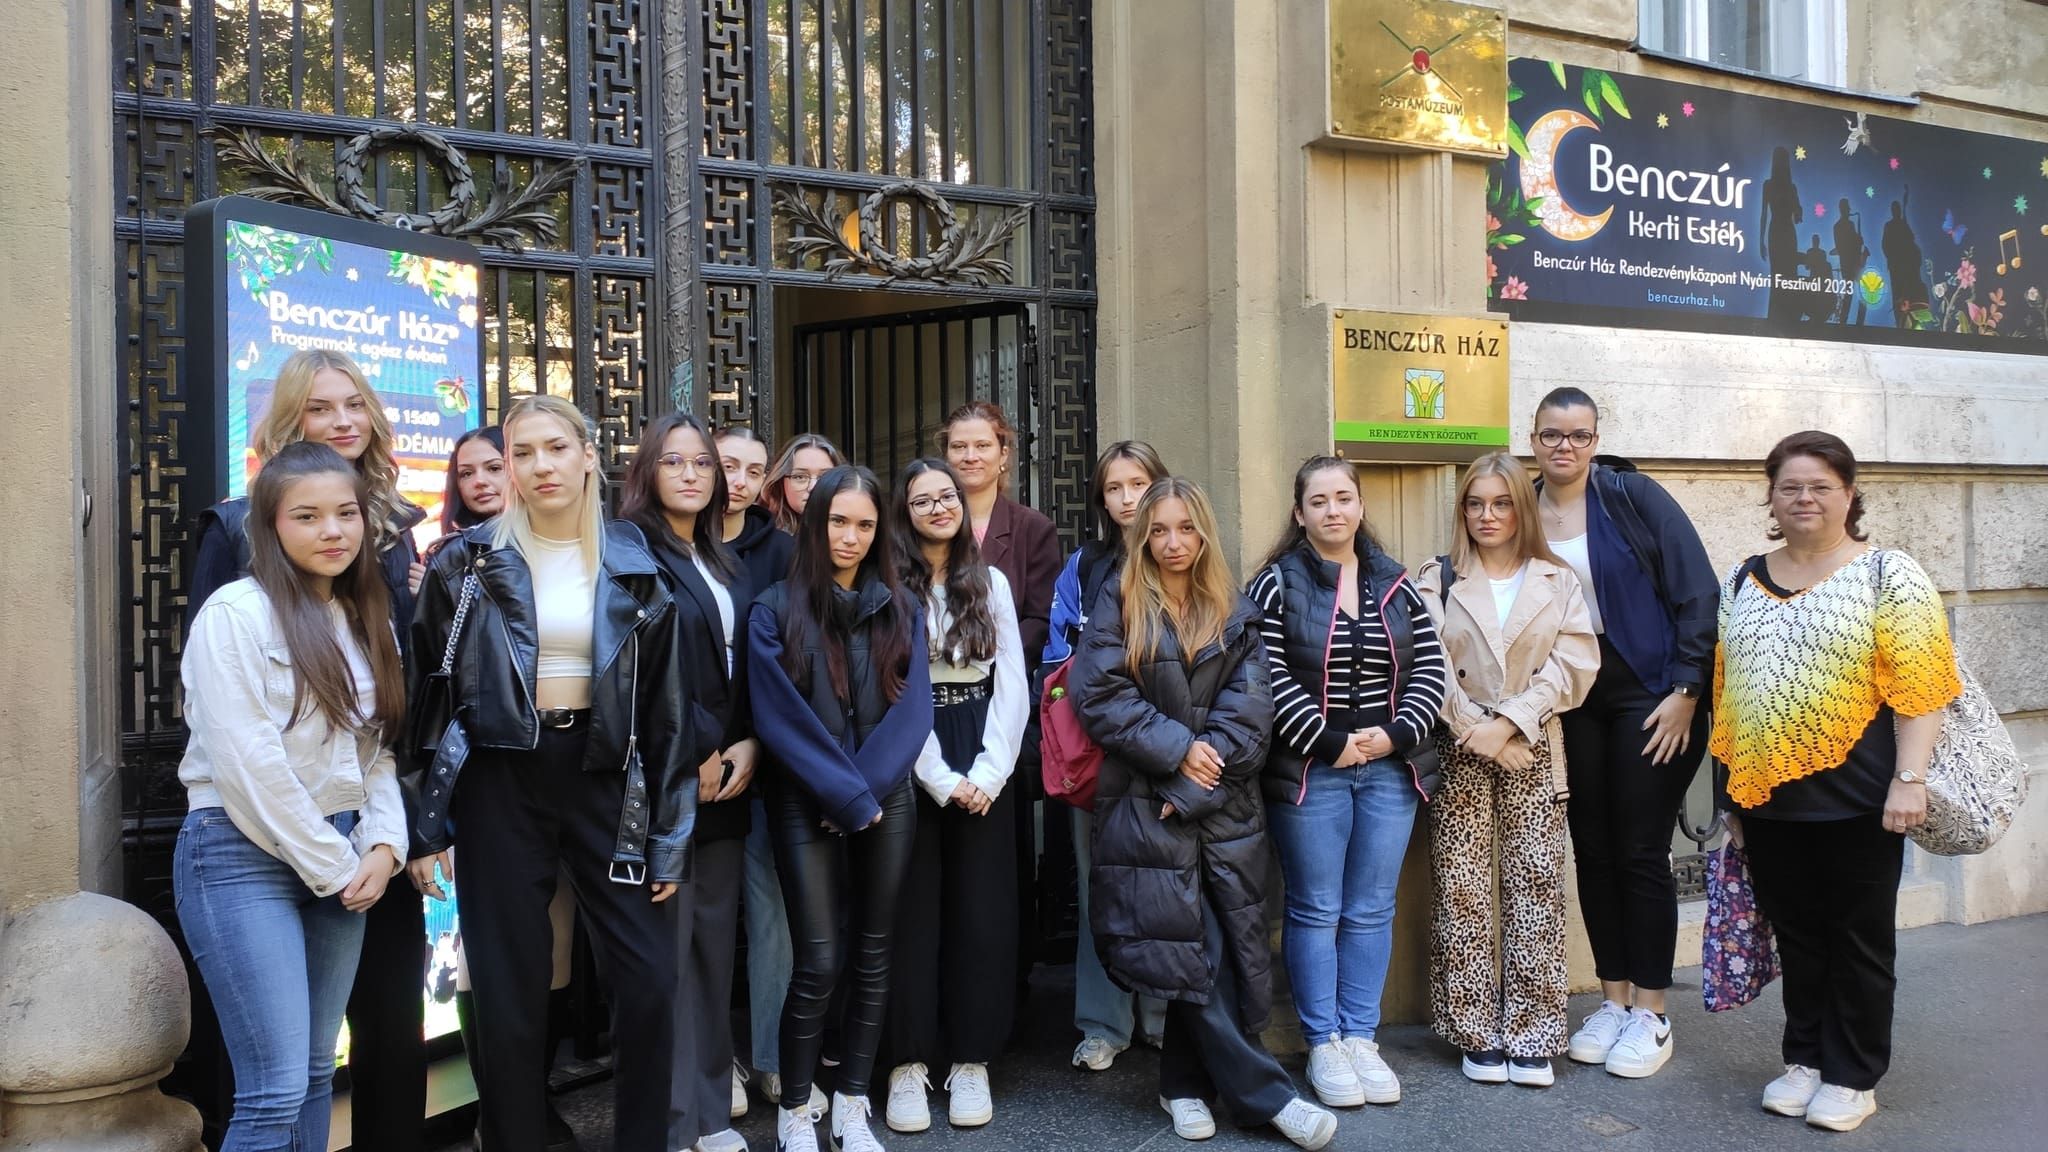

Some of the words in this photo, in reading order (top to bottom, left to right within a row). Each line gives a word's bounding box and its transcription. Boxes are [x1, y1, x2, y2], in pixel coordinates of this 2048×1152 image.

[1589, 143, 1752, 209] Benczúr
[1629, 210, 1680, 241] Kerti
[1687, 216, 1745, 254] Esték
[1534, 250, 1586, 271] Benczúr
[1590, 256, 1616, 274] Ház
[1619, 259, 1737, 287] Rendezvényközpont
[1740, 271, 1771, 291] Nyári
[1775, 273, 1821, 292] Fesztivál
[1824, 278, 1854, 295] 2023
[1647, 288, 1726, 308] benczurhaz.hu
[269, 290, 391, 336] Benczúr
[399, 310, 450, 346] Ház
[271, 325, 358, 353] Programok
[1344, 326, 1446, 354] BENCZÚR
[1457, 330, 1500, 357] HÁZ
[1369, 428, 1479, 441] RENDEZVÉNYKÖZPONT
